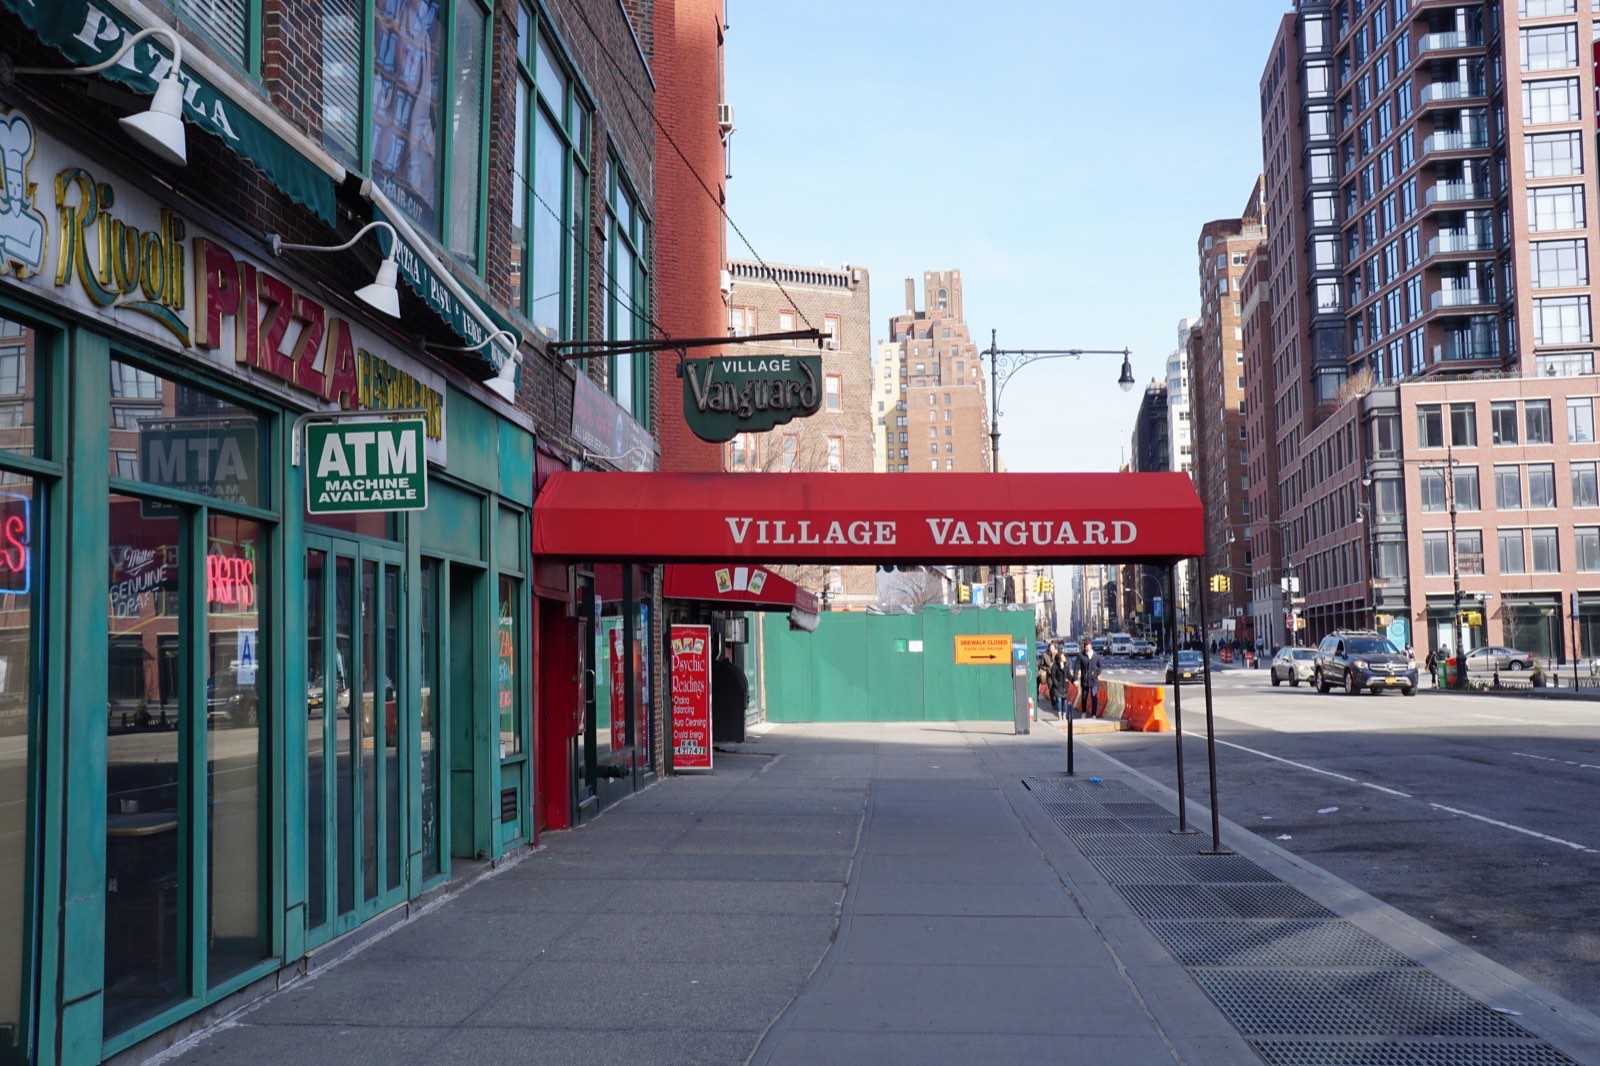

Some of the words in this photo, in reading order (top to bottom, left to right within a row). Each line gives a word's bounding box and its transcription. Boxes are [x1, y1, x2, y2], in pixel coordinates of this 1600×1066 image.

[55, 168, 186, 310] Rivoli
[194, 237, 359, 411] PIZZA
[722, 359, 791, 372] VILLAGE
[686, 360, 818, 417] Vanguard
[316, 430, 417, 478] ATM
[318, 488, 417, 503] AVAILABLE
[325, 478, 409, 490] MACHINE
[725, 517, 897, 545] VILLAGE
[926, 518, 1138, 546] VANGUARD
[110, 564, 168, 602] GENUINE
[117, 587, 160, 619] DRAFT
[672, 655, 705, 678] Psychic
[672, 676, 704, 698] Readings
